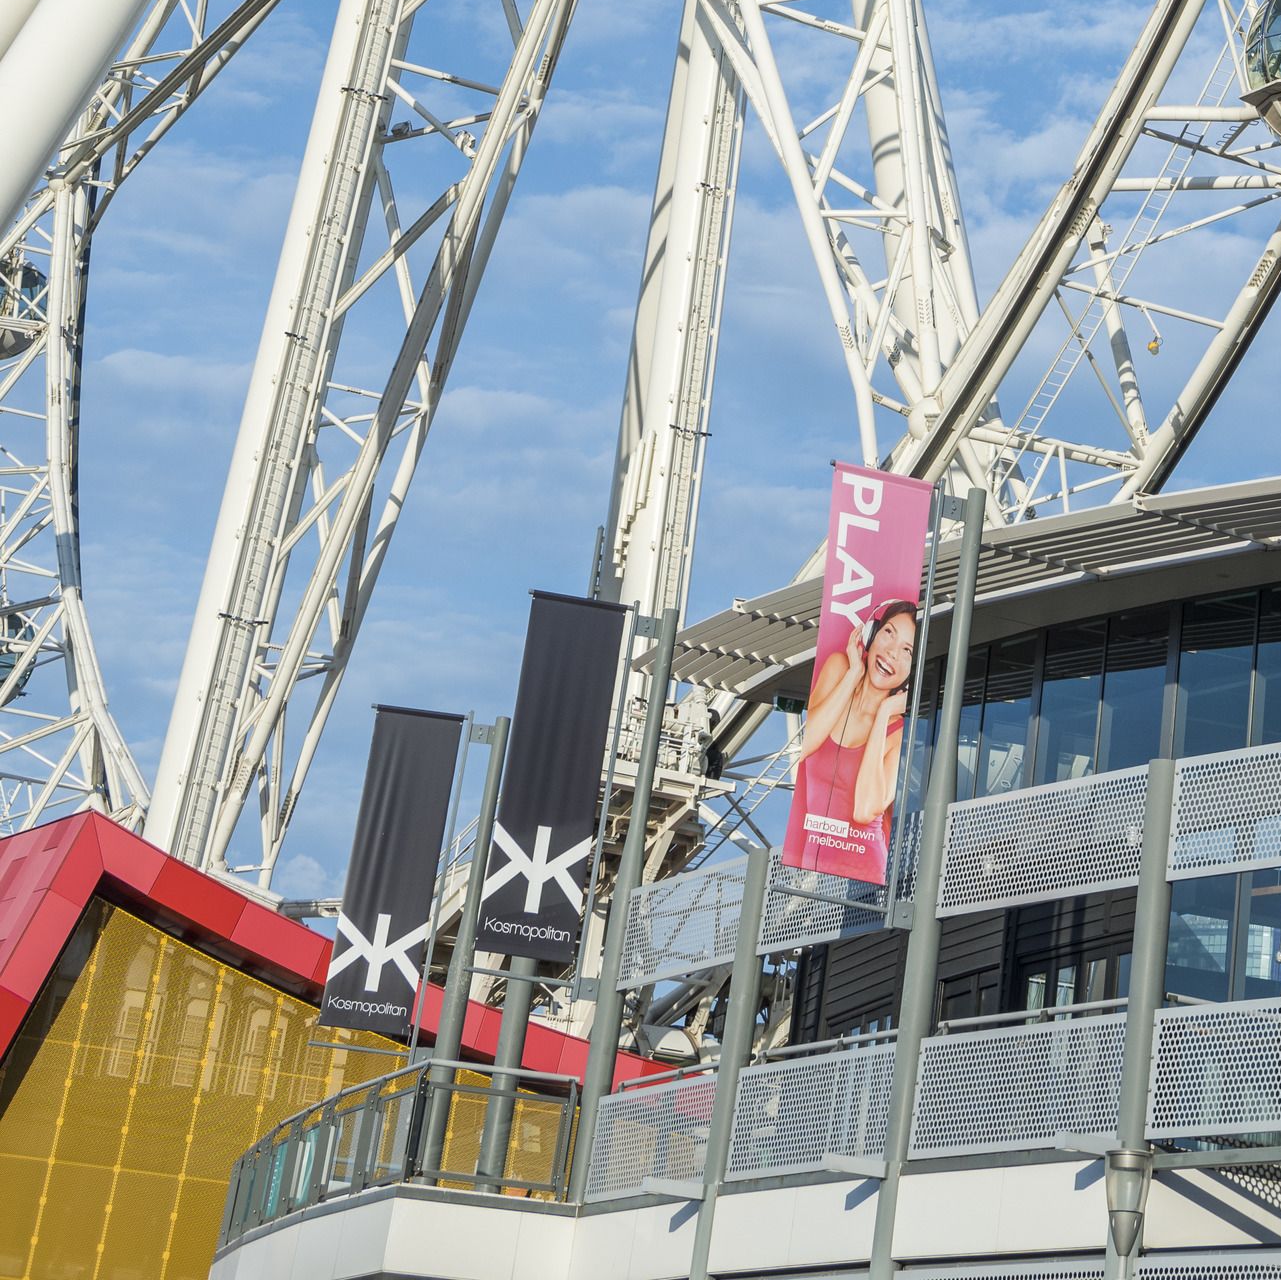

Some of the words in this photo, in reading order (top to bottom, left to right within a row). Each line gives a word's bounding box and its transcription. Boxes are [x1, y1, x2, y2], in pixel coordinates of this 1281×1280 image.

[830, 472, 883, 628] PLAY
[805, 817, 848, 834] harbour
[849, 826, 875, 841] town
[808, 834, 866, 854] melbourne
[484, 916, 571, 942] Kosmopolitan
[327, 995, 407, 1017] Kosmopolitan
